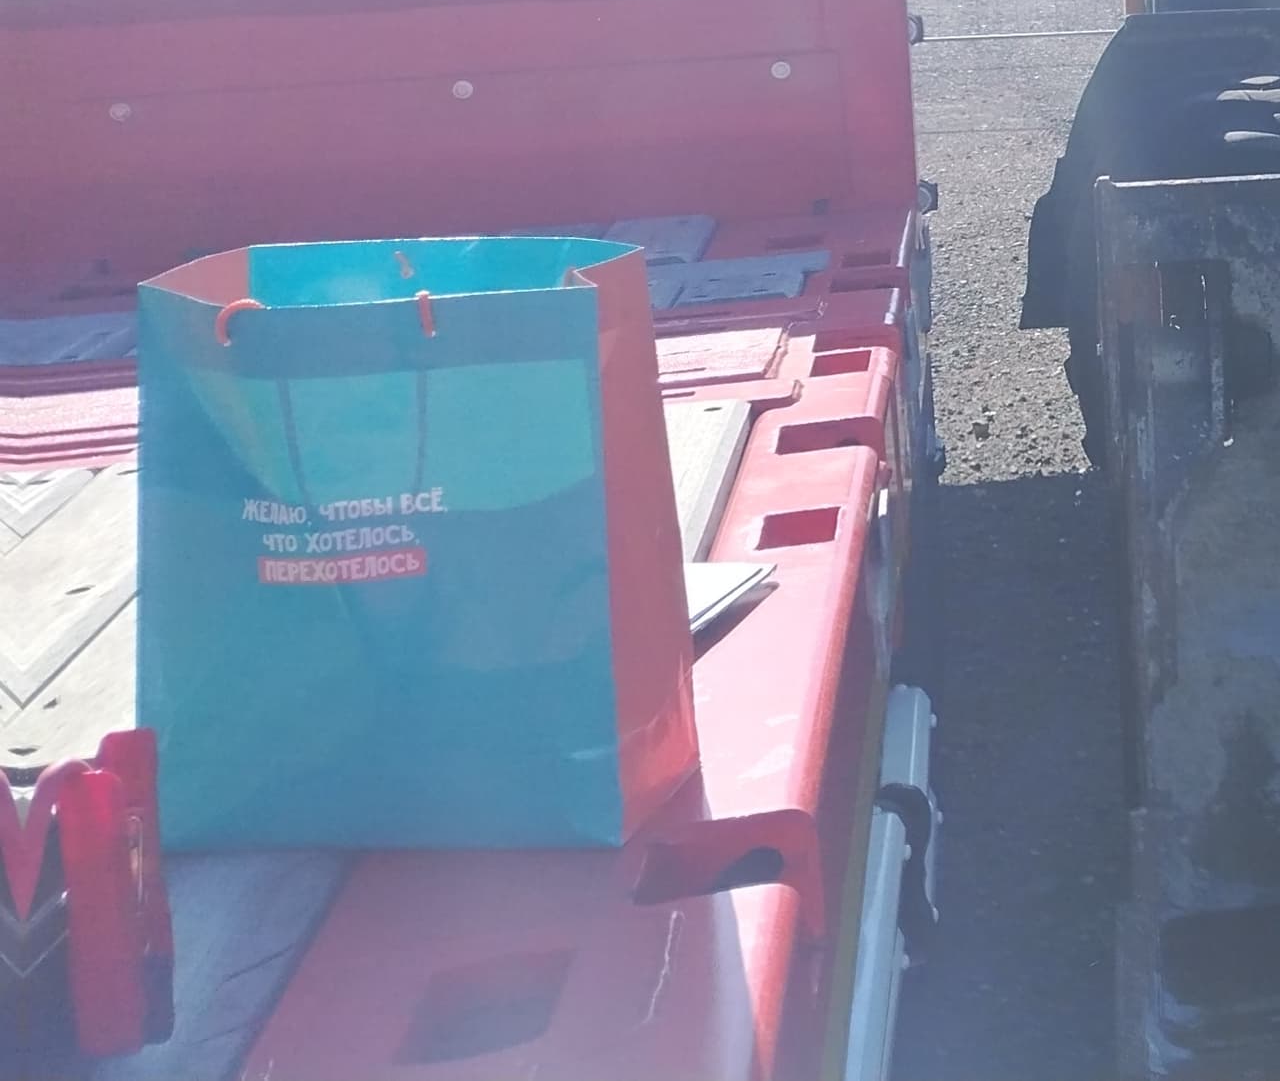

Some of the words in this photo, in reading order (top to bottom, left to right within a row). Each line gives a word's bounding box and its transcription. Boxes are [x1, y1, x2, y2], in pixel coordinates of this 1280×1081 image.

[242, 498, 313, 526] ЖЕЛАЮ,
[319, 496, 393, 522] ЧТОБЫ
[263, 533, 298, 553] ЧТО
[304, 524, 421, 554] ХОТЕЛОСЬ,
[264, 552, 421, 582] ПЕРЕХОТЕЛОСЬ
